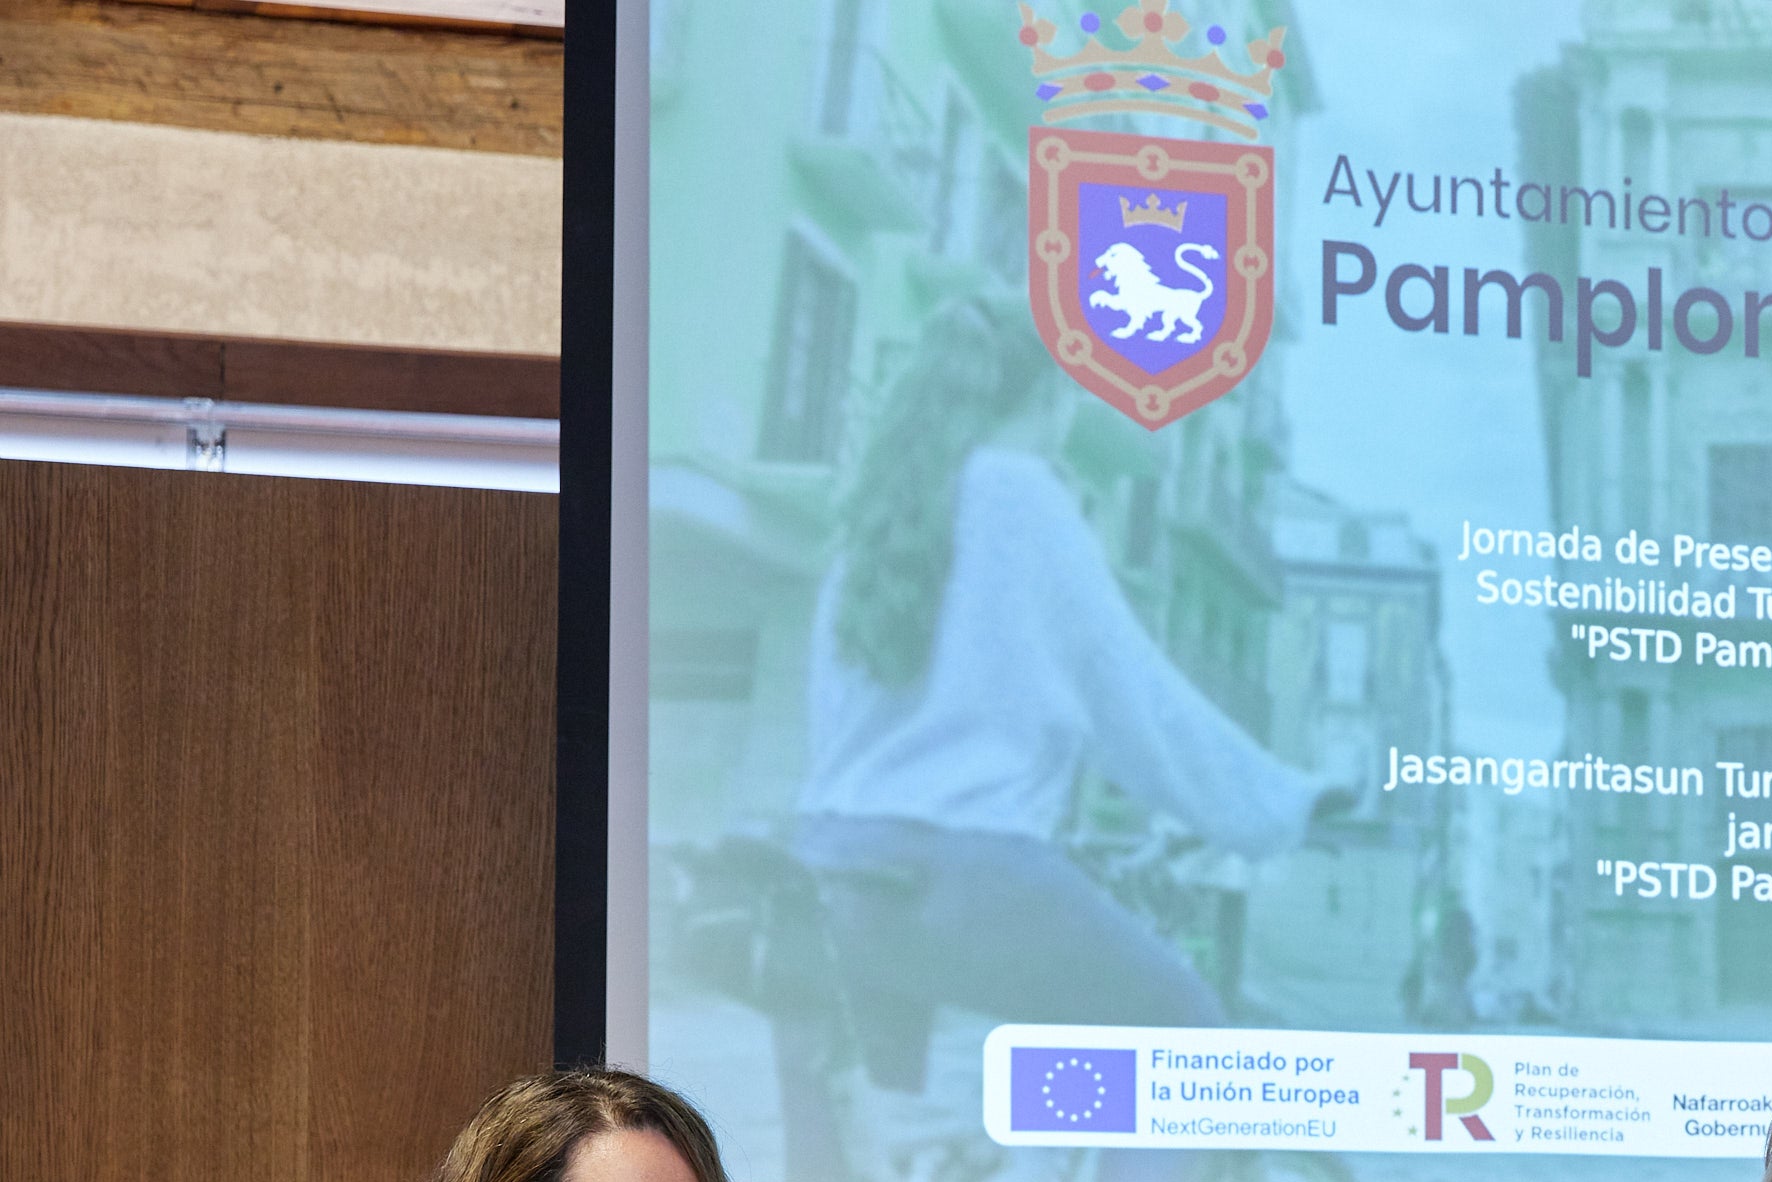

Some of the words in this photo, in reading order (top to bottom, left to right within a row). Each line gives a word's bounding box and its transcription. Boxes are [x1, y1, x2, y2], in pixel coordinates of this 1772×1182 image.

[1460, 521, 1602, 562] Jornada
[1616, 530, 1660, 566] de
[1476, 569, 1736, 618] Sostenibilidad
[1571, 625, 1682, 664] "PSTD
[1385, 747, 1703, 800] Jasangarritasun
[1596, 860, 1717, 898] "PSTD
[1152, 1050, 1286, 1071] Financiado
[1296, 1057, 1334, 1075] por
[1515, 1062, 1552, 1077] Plan
[1559, 1063, 1579, 1077] de
[1152, 1081, 1171, 1100] la
[1181, 1082, 1252, 1101] Unión
[1262, 1083, 1360, 1107] Europea
[1515, 1083, 1640, 1103] Recuperación,
[1515, 1105, 1651, 1121] Transformación
[1151, 1117, 1337, 1138] NextGenerationEU
[1515, 1129, 1523, 1142] y
[1531, 1126, 1624, 1142] Resiliencia
